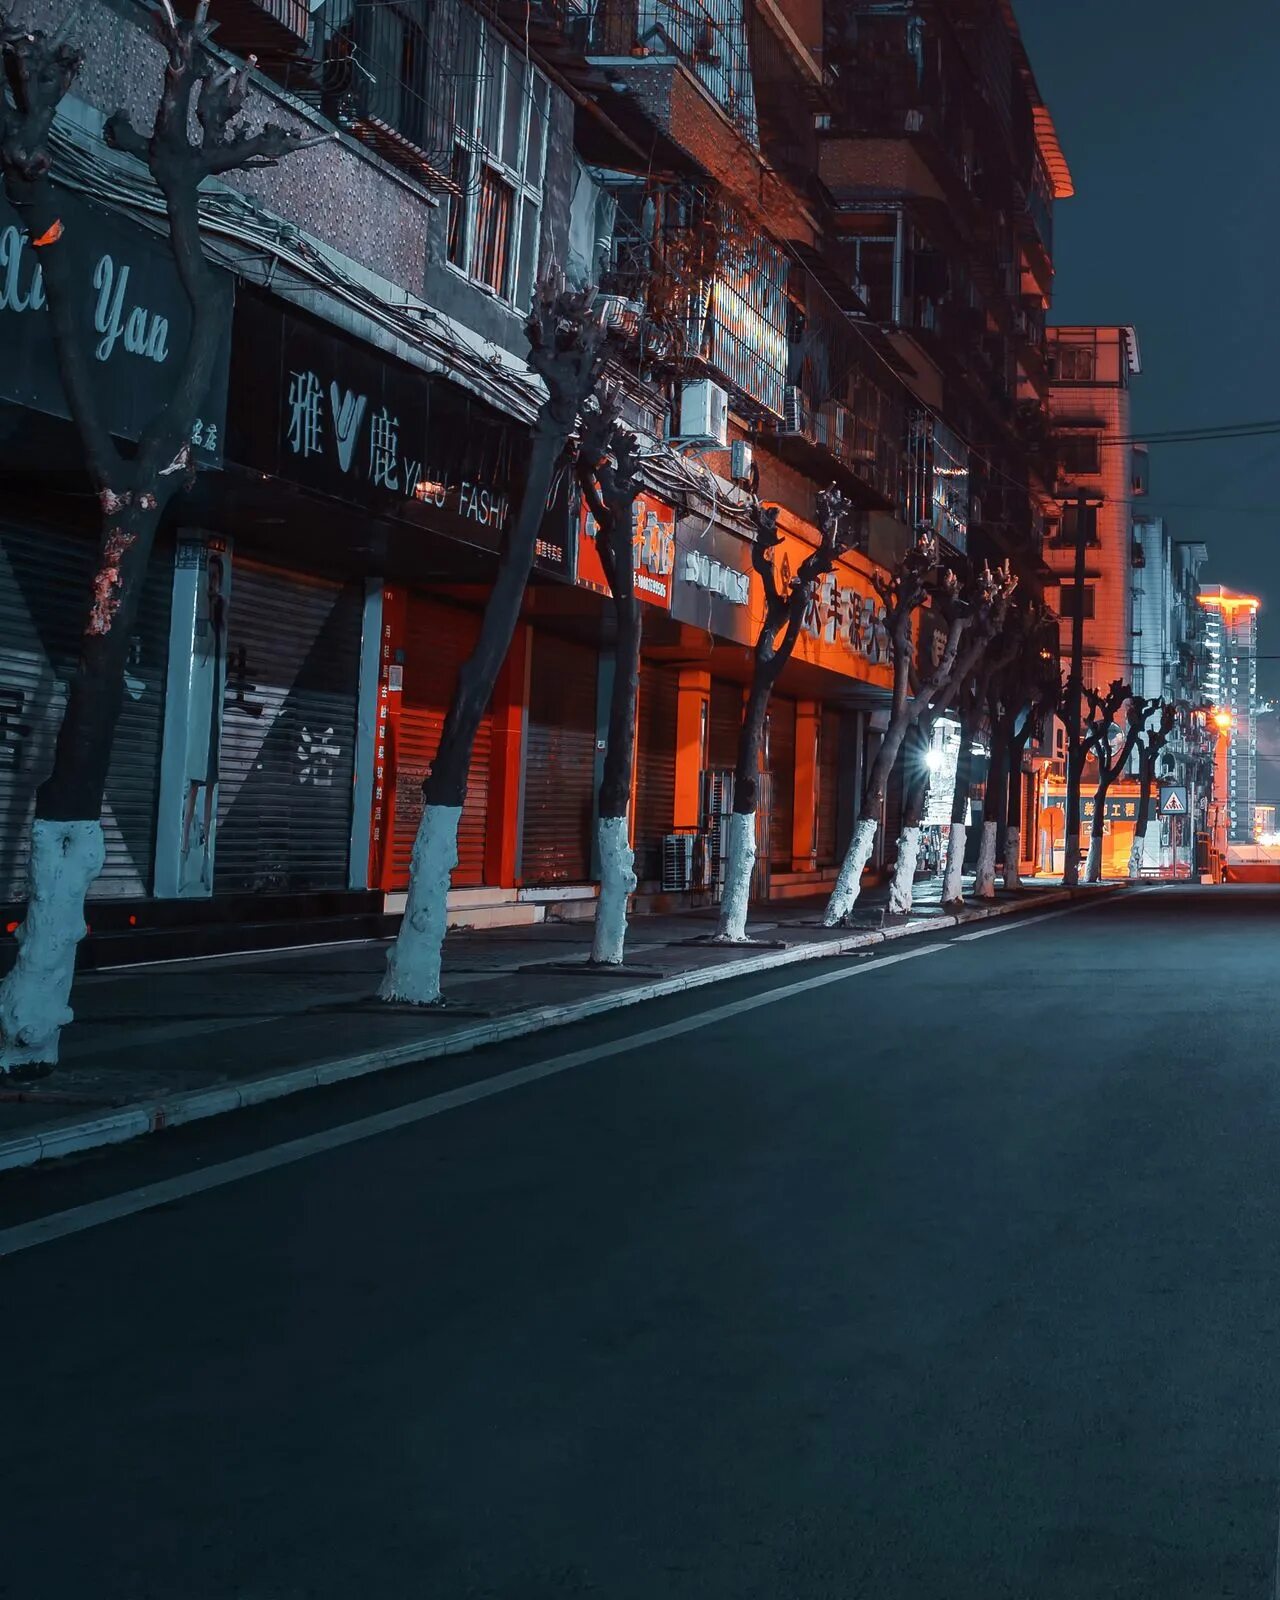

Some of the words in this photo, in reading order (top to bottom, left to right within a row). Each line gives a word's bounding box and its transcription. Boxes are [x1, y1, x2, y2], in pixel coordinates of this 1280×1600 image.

[93, 254, 169, 362] Yan
[403, 456, 448, 508] YALU
[458, 481, 509, 530] FASHI
